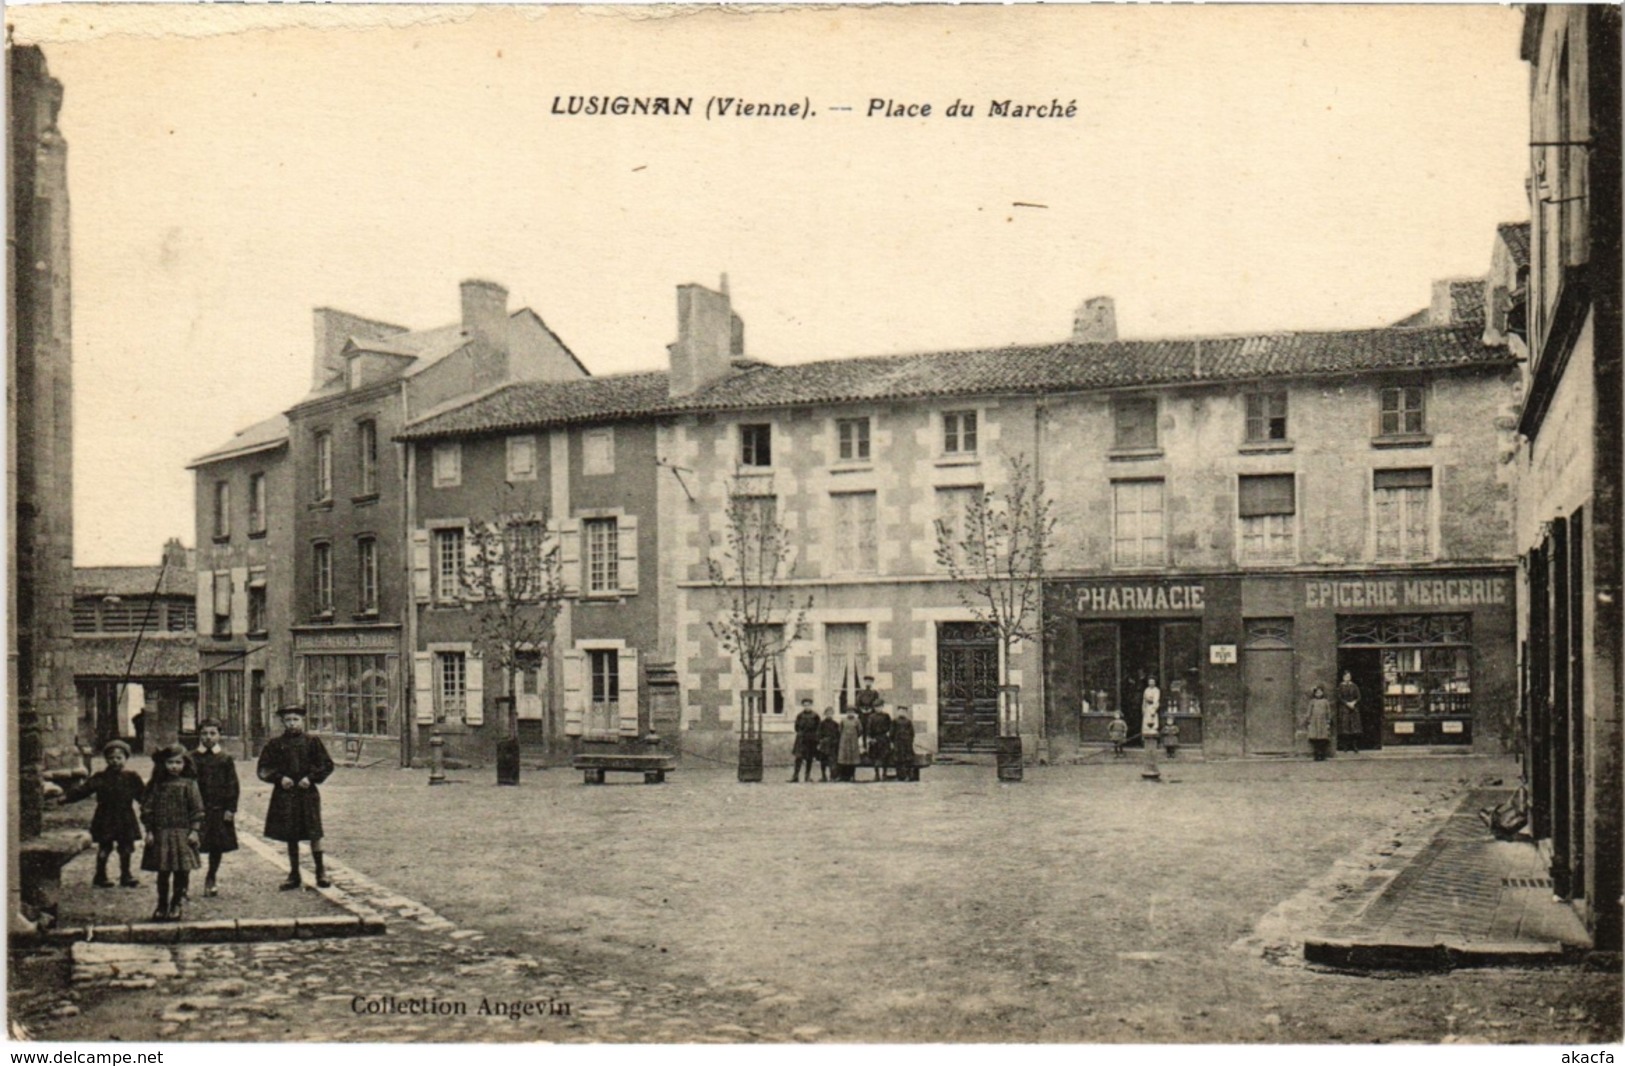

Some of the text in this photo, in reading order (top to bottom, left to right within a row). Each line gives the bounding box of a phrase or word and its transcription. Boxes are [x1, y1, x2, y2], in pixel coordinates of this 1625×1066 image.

[1076, 585, 1206, 611] PHARMACIE
[1305, 578, 1507, 609] EPICERIE MERCERIE
